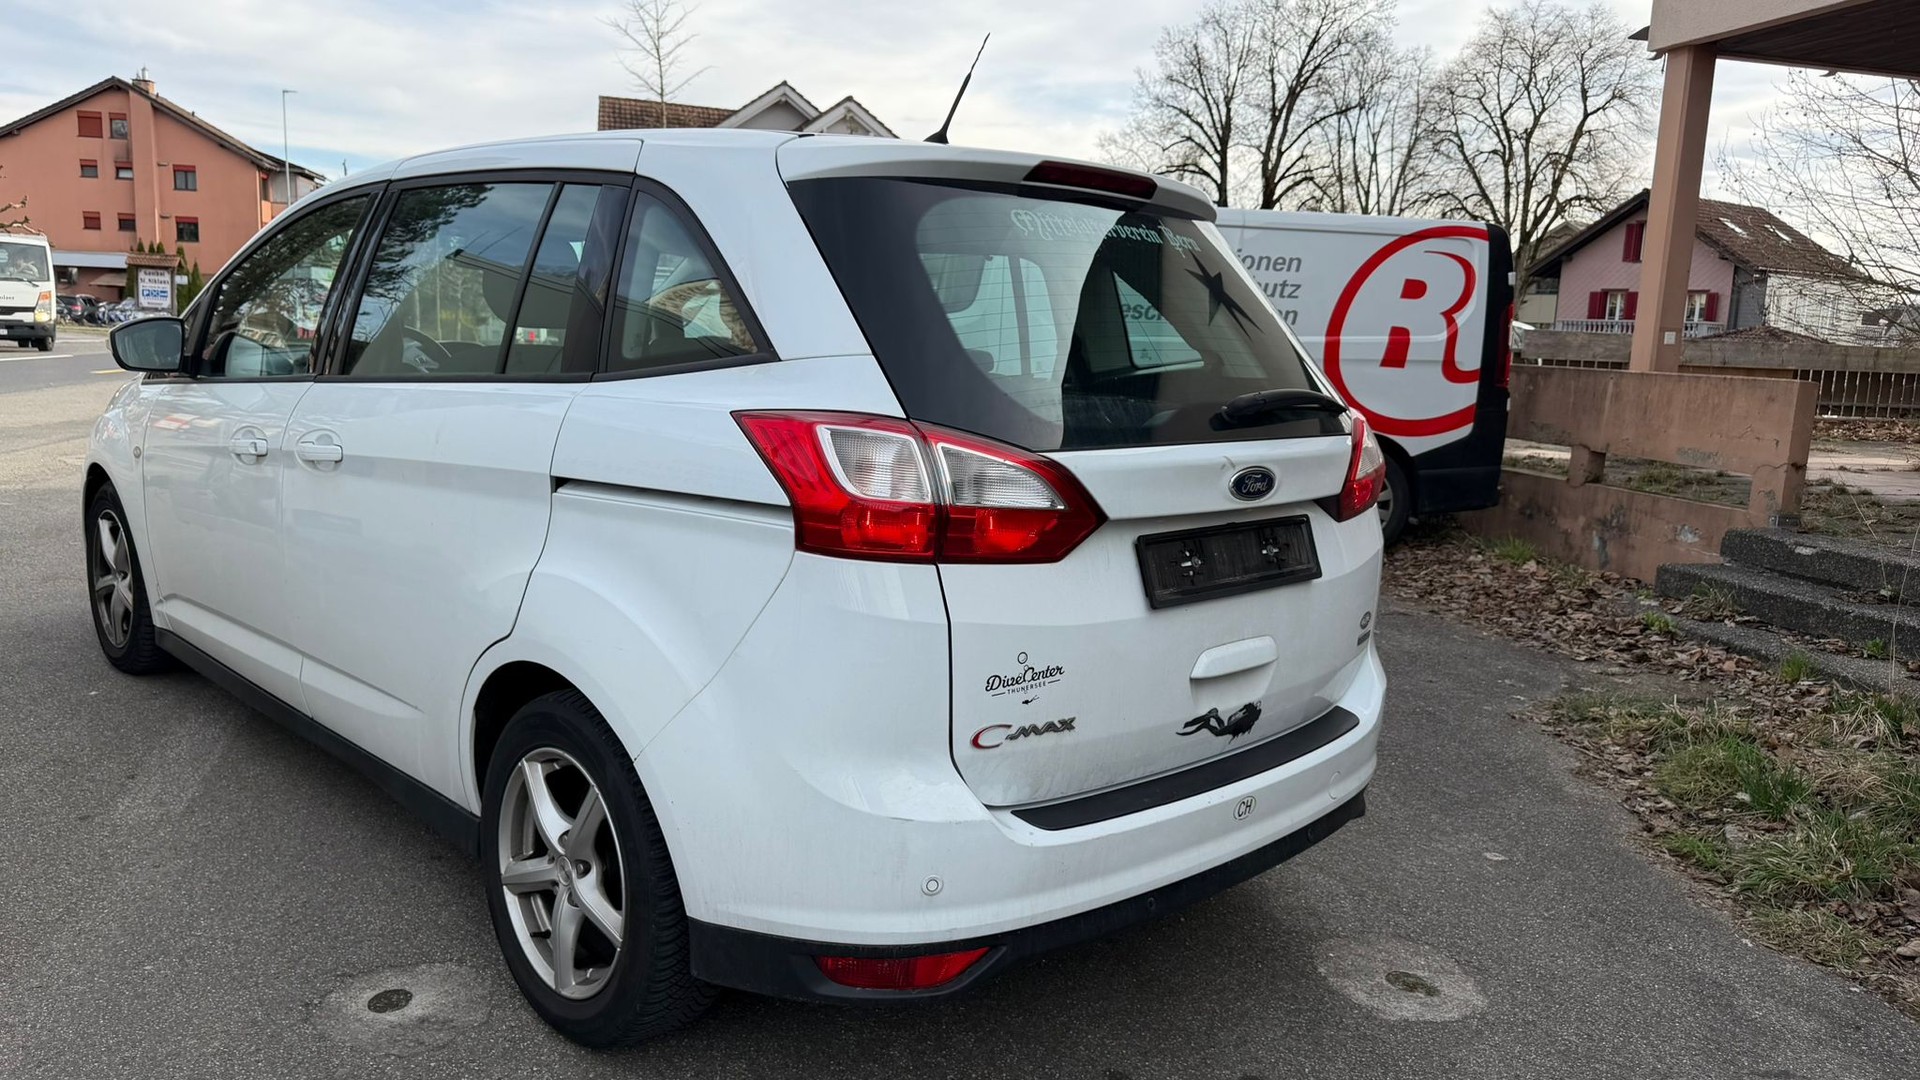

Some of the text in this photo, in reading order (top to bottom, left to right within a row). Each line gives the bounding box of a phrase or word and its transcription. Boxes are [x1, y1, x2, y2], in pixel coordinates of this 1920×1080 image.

[1257, 279, 1302, 299] utz
[1241, 474, 1269, 494] Ford
[1007, 681, 1047, 695] THUNERSEE
[1237, 798, 1254, 818] CH
